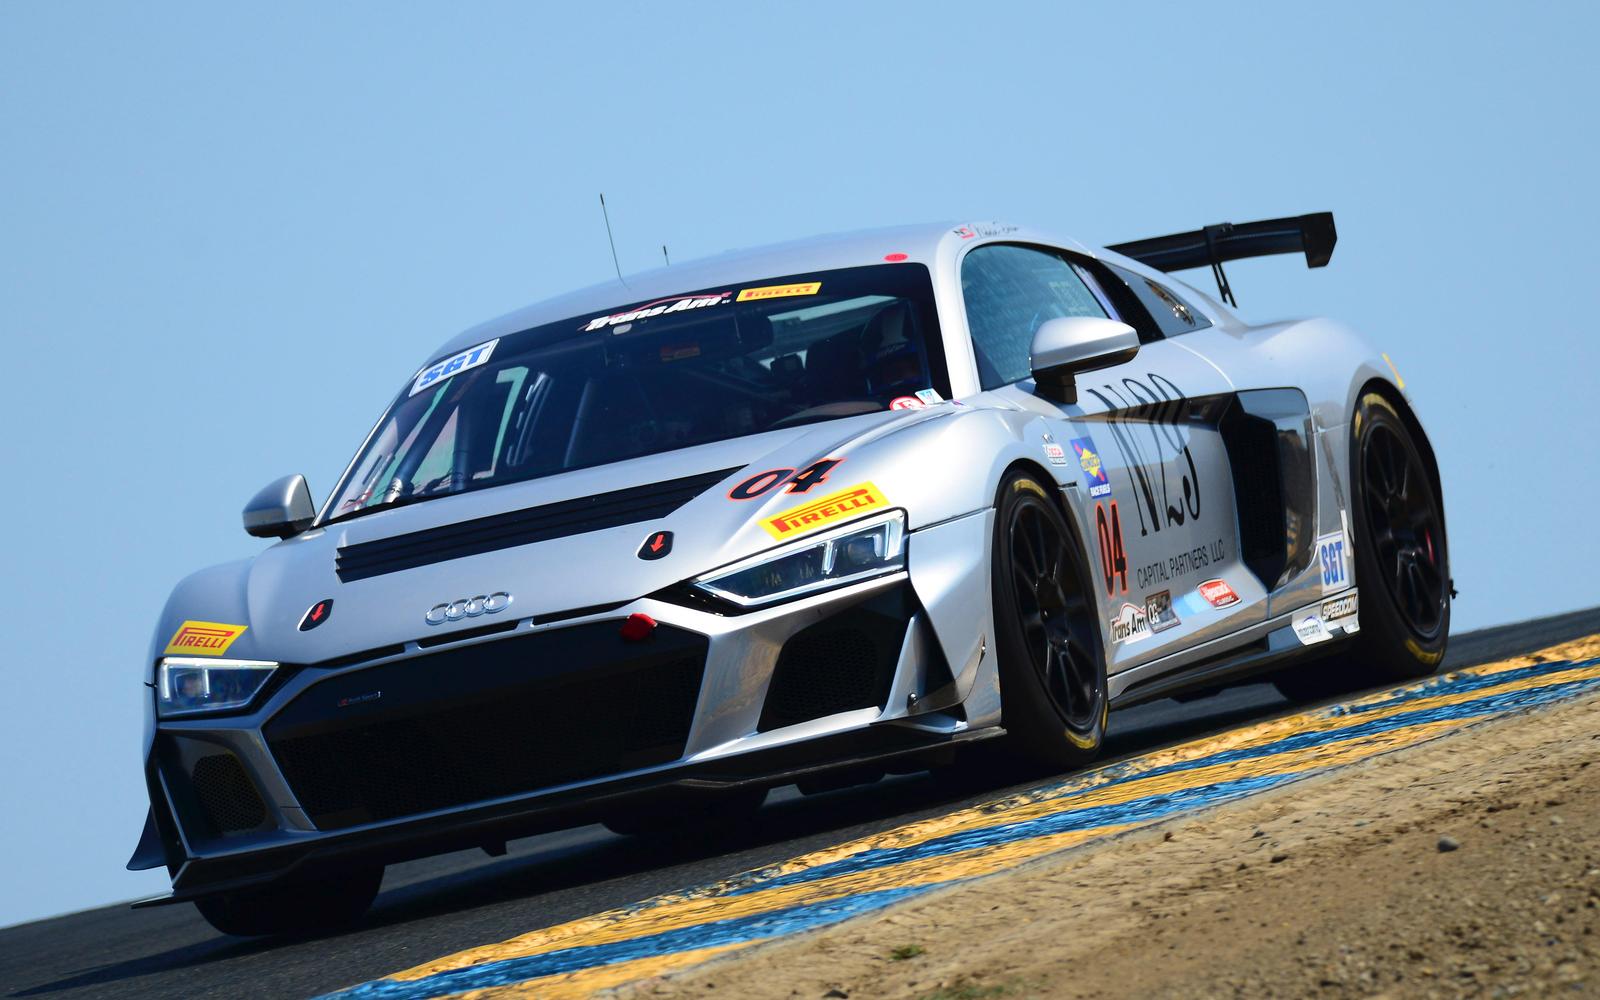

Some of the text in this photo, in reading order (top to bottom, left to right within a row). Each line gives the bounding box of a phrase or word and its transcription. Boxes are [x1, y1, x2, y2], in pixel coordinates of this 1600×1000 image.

[420, 344, 490, 387] SGT
[726, 457, 848, 500] 04
[770, 488, 876, 533] PIRELLI
[1095, 499, 1128, 598] 04
[1136, 539, 1225, 590] CAPITAL PARTNERS LLC
[1320, 541, 1345, 585] SGT
[172, 626, 235, 649] PIRELLI
[1111, 620, 1131, 641] Trans
[1131, 613, 1146, 633] Am
